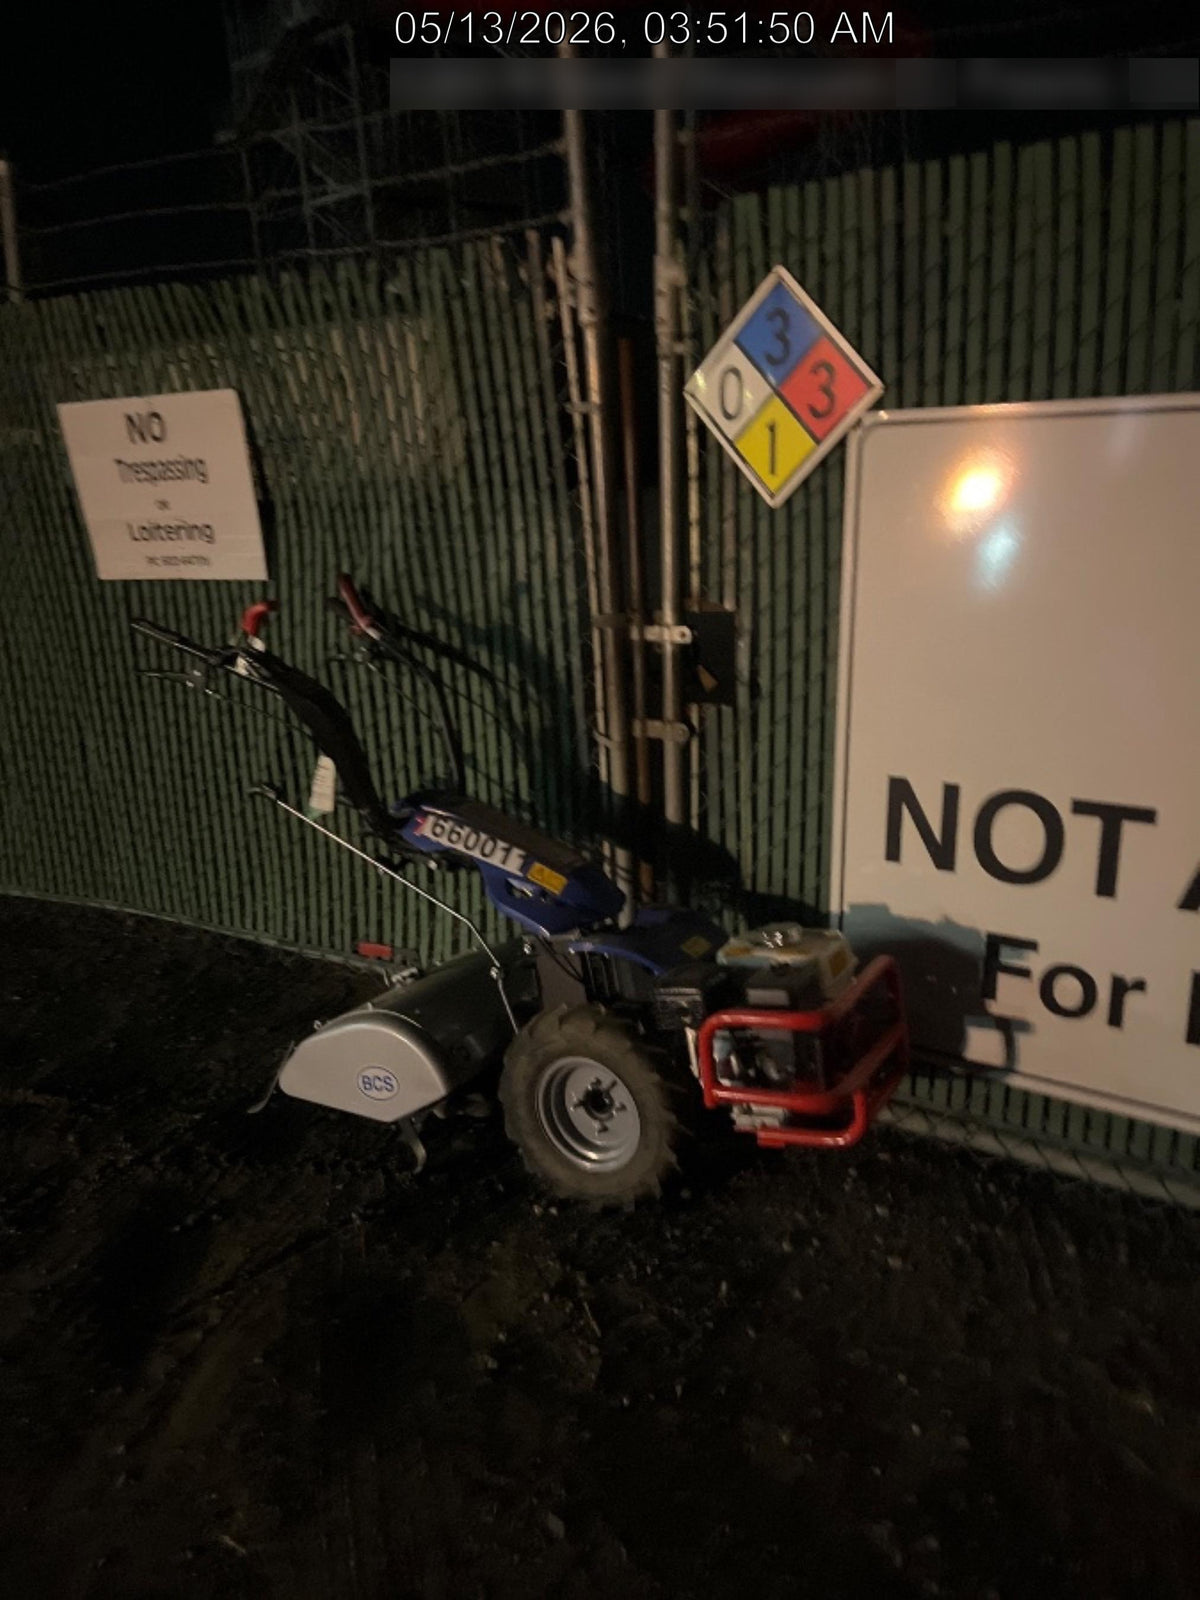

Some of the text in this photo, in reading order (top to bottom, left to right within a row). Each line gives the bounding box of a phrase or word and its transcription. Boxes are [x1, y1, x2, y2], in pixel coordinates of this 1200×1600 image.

[765, 307, 791, 366] 3
[719, 360, 836, 420] 0 3
[124, 410, 167, 445] NO
[766, 421, 777, 476] 1
[114, 455, 210, 485] Trespassing
[126, 520, 216, 544] Loitering
[885, 775, 1157, 899] NOT
[980, 931, 1146, 1028] For
[361, 1074, 395, 1093] BCS
